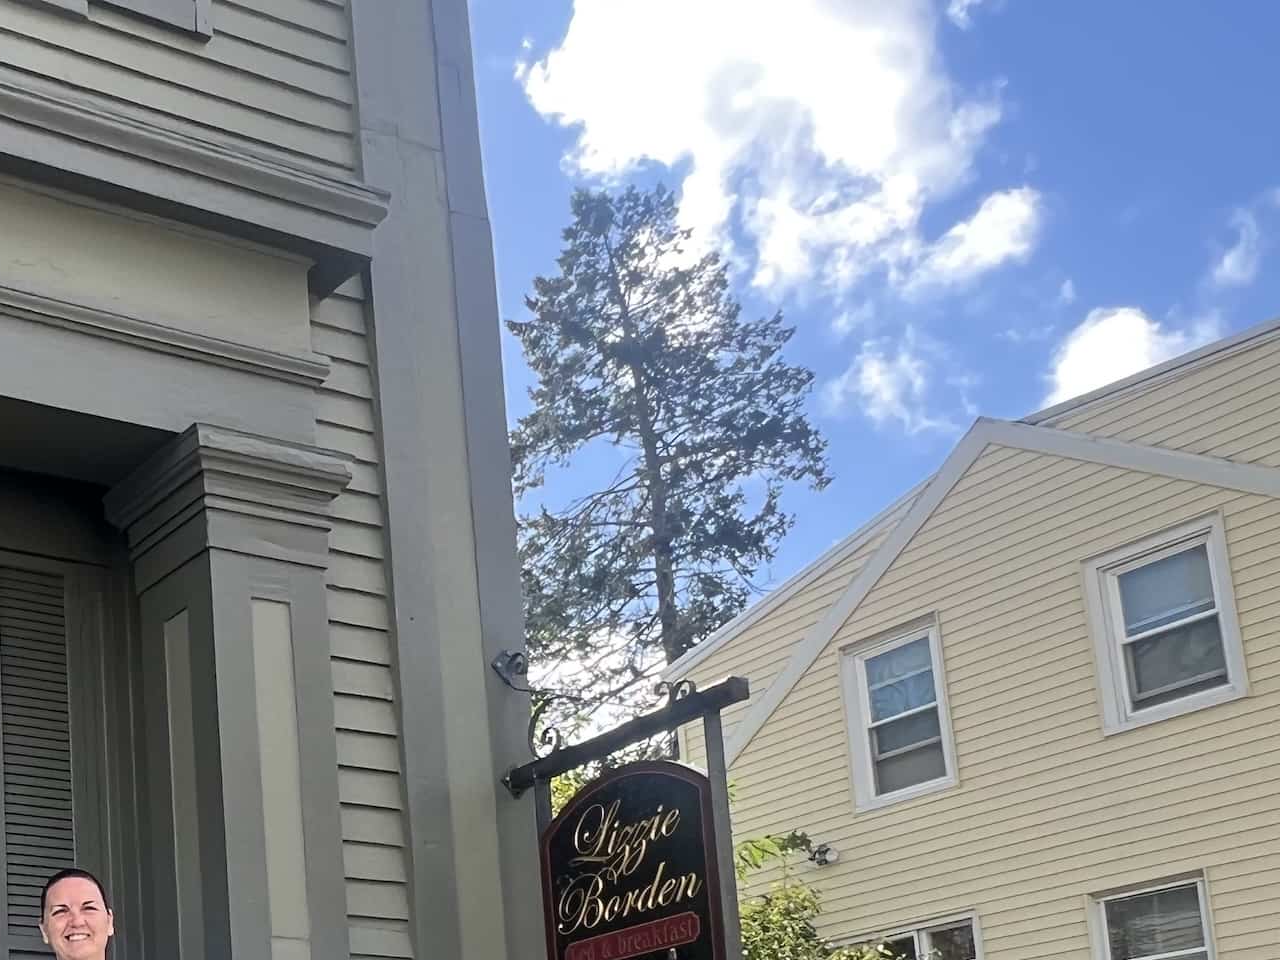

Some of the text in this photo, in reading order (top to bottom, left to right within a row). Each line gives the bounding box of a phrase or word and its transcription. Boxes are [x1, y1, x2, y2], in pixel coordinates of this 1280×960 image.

[571, 800, 681, 884] Lizzie
[558, 861, 702, 934] Borden
[617, 917, 693, 955] breakfast
